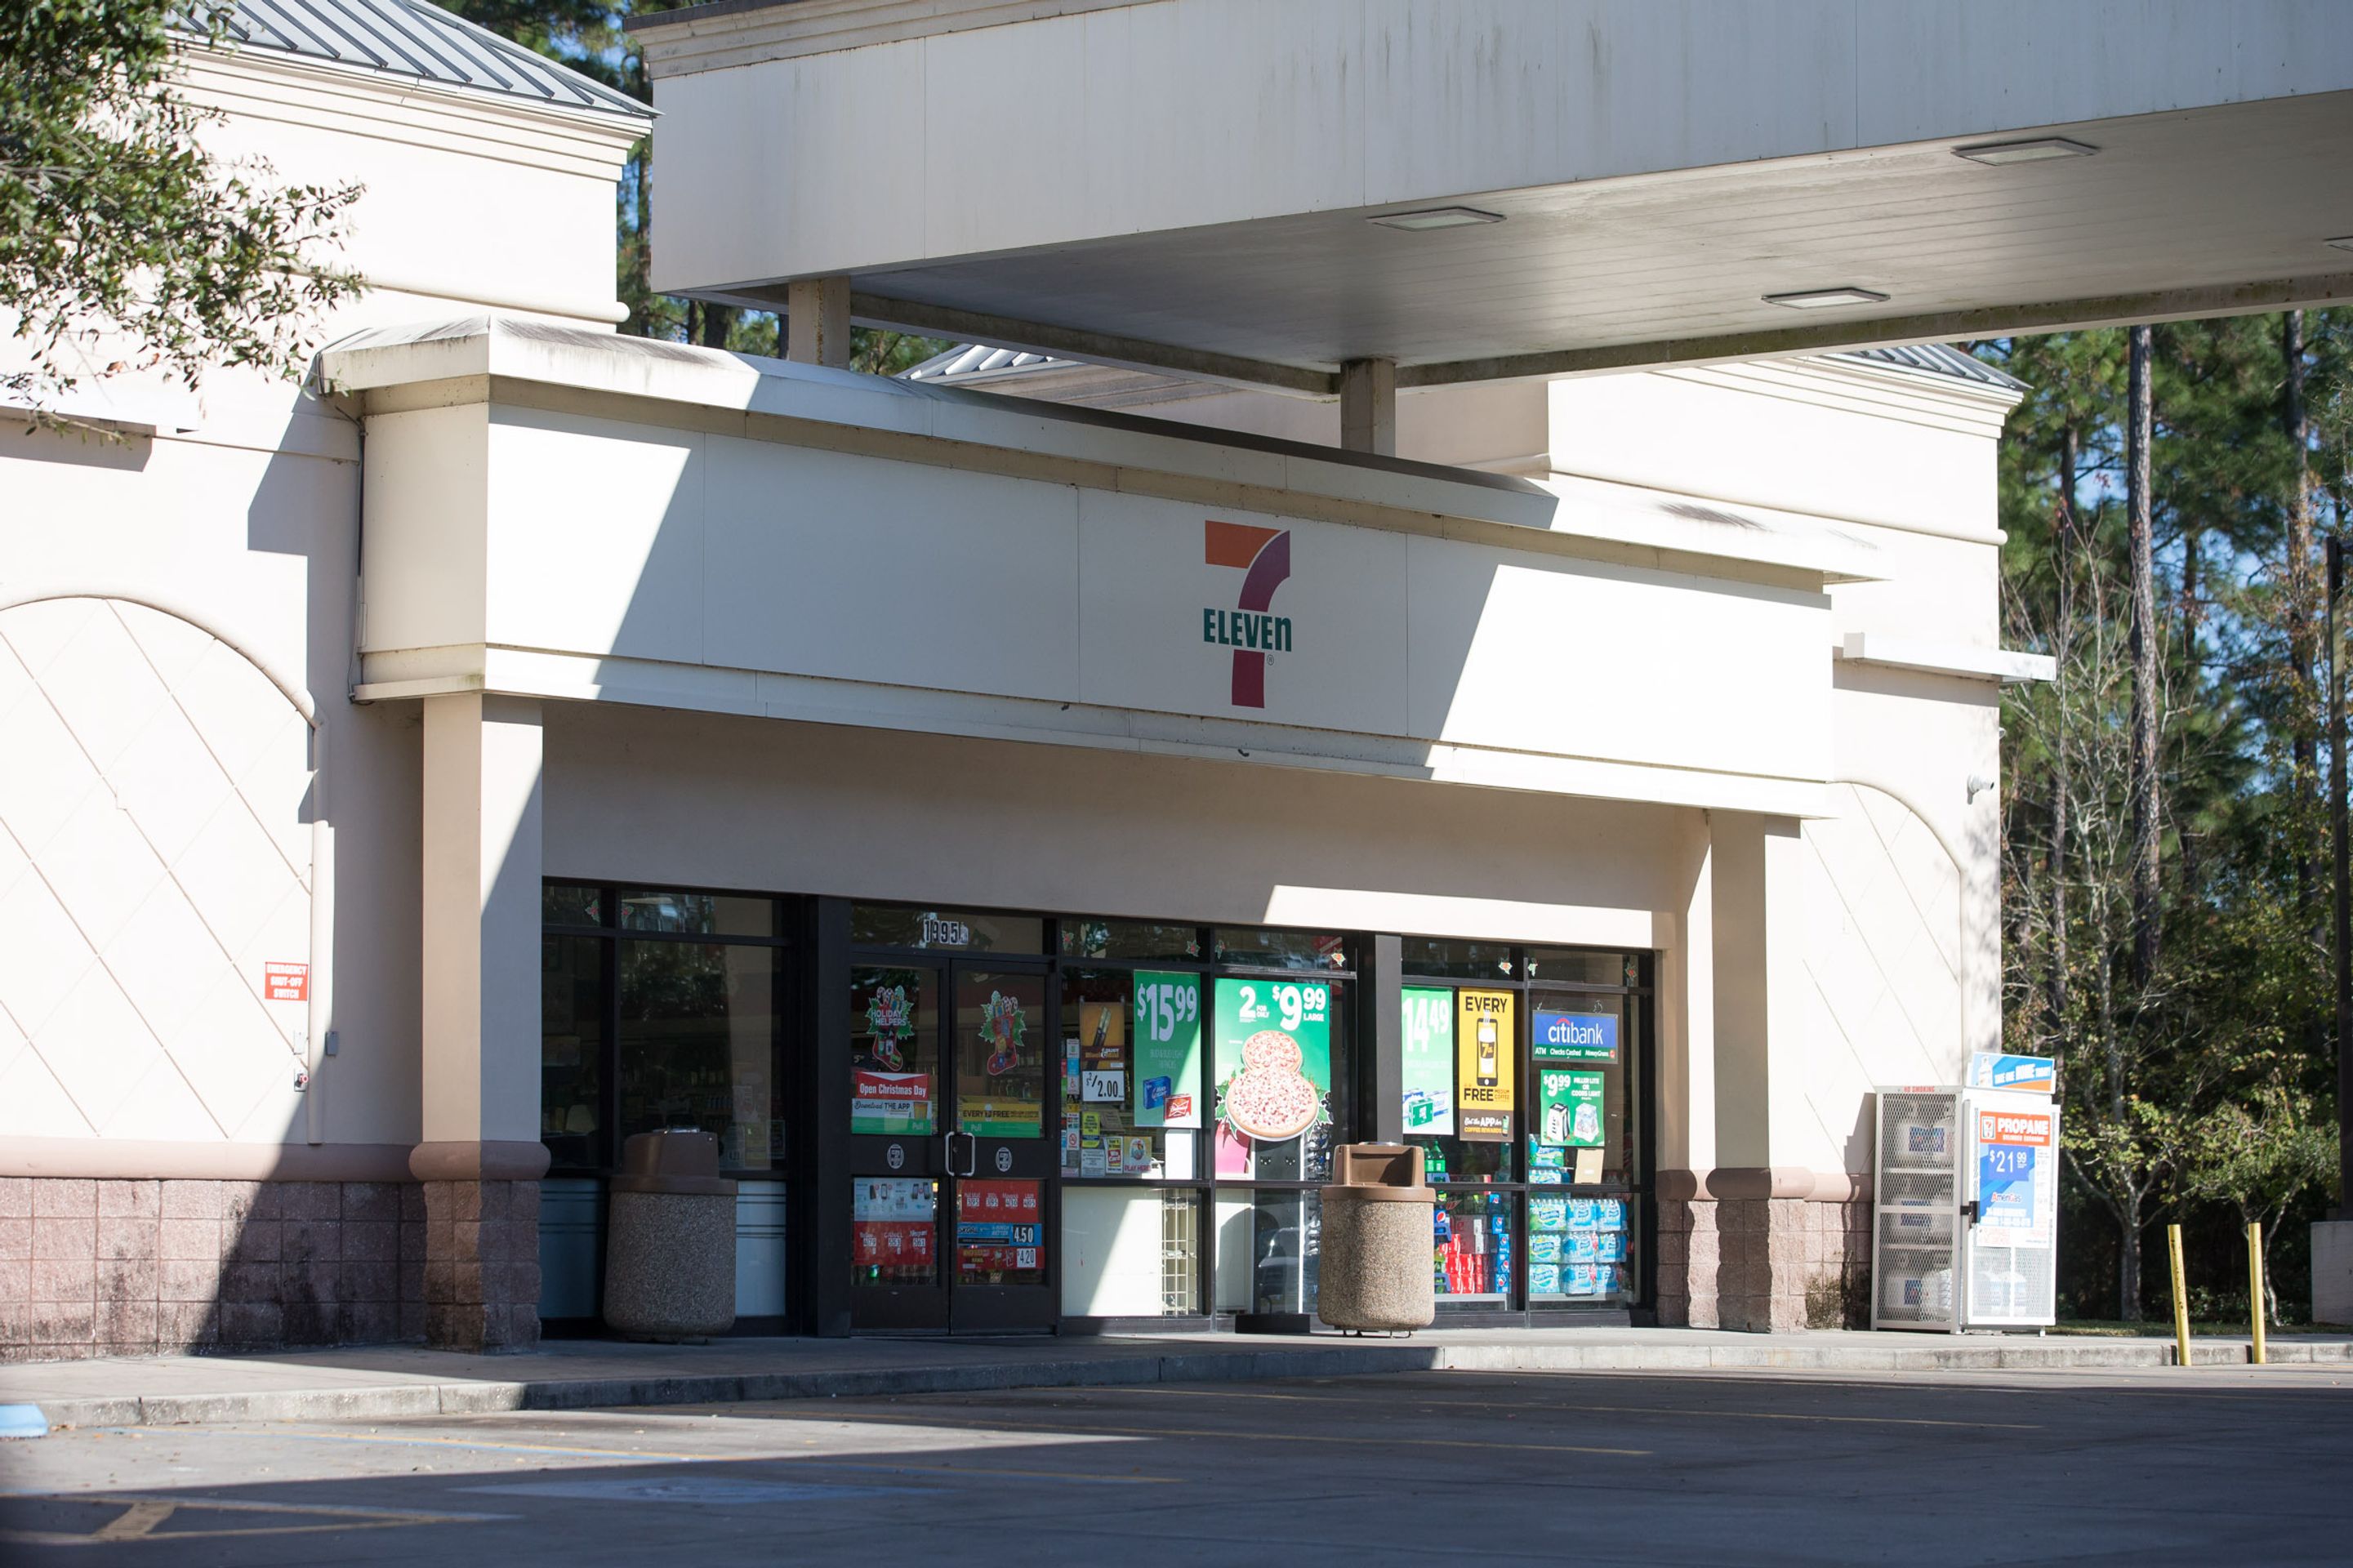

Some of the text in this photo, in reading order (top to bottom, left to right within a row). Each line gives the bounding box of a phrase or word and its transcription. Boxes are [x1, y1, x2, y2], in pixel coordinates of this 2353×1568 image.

[266, 964, 307, 976] EMERGENCY
[270, 976, 303, 987] SHUT-OFF
[274, 988, 300, 999] SWITCH
[1239, 986, 1256, 1019] 2
[1465, 996, 1508, 1013] EVERY
[871, 1009, 902, 1018] HOLIDAY
[1303, 1013, 1325, 1022] LARGE
[876, 1018, 907, 1026] HELPERS
[1548, 1019, 1603, 1045] citibank
[1535, 1047, 1547, 1055] ATM
[1550, 1048, 1565, 1056] Checks
[1566, 1049, 1581, 1057] Cashed
[860, 1083, 927, 1098] Open Christmas Day
[1464, 1088, 1494, 1102] FREE
[885, 1102, 897, 1110] THE
[1480, 1116, 1495, 1127] APP
[1998, 1116, 2048, 1135] PROPANE
